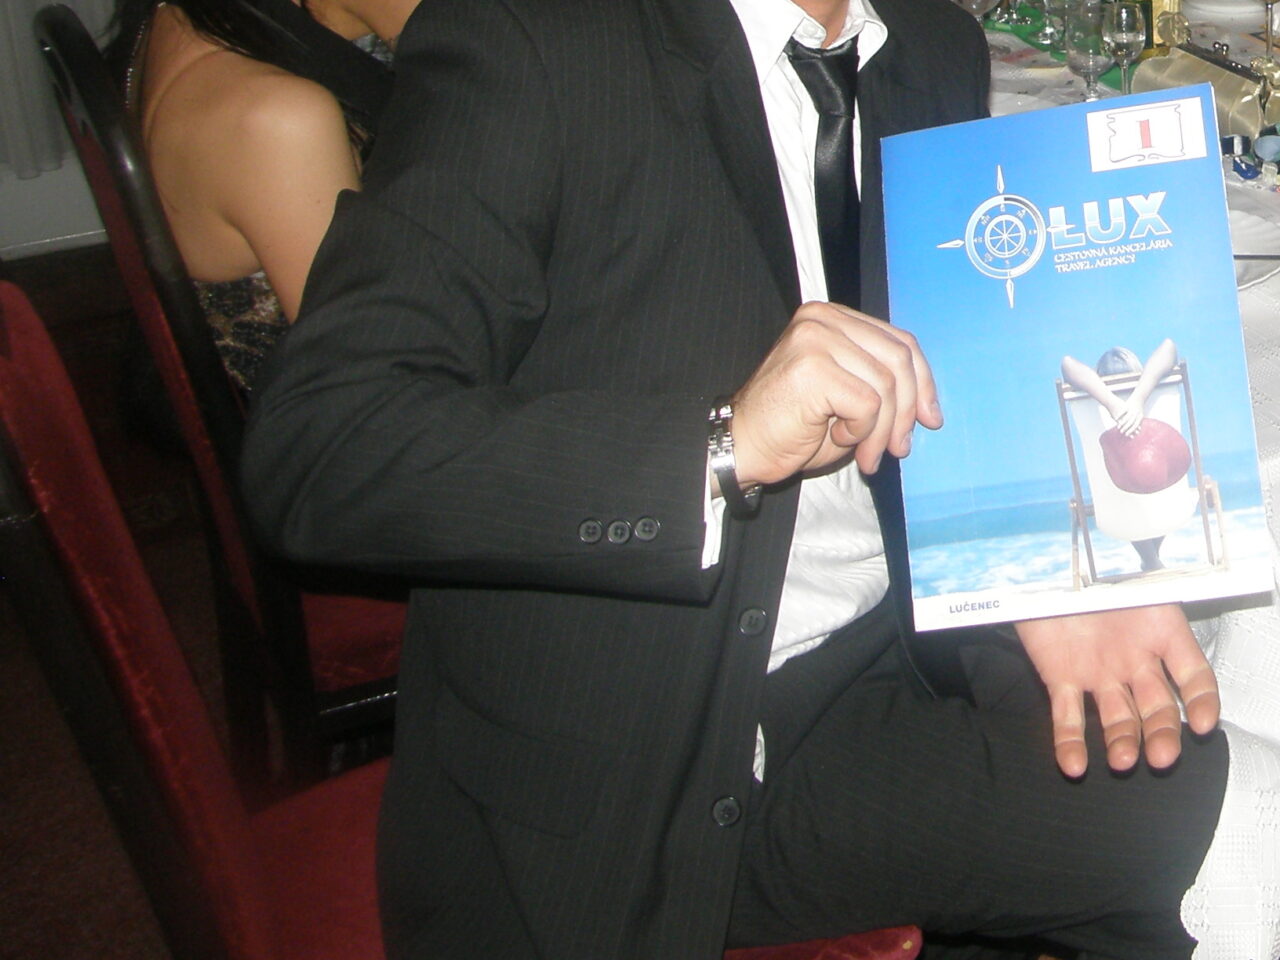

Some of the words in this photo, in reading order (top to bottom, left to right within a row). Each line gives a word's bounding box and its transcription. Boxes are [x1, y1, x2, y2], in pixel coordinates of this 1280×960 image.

[1046, 191, 1173, 250] LUX
[1055, 261, 1094, 273] TRAVEL
[1095, 253, 1136, 270] AGENCY
